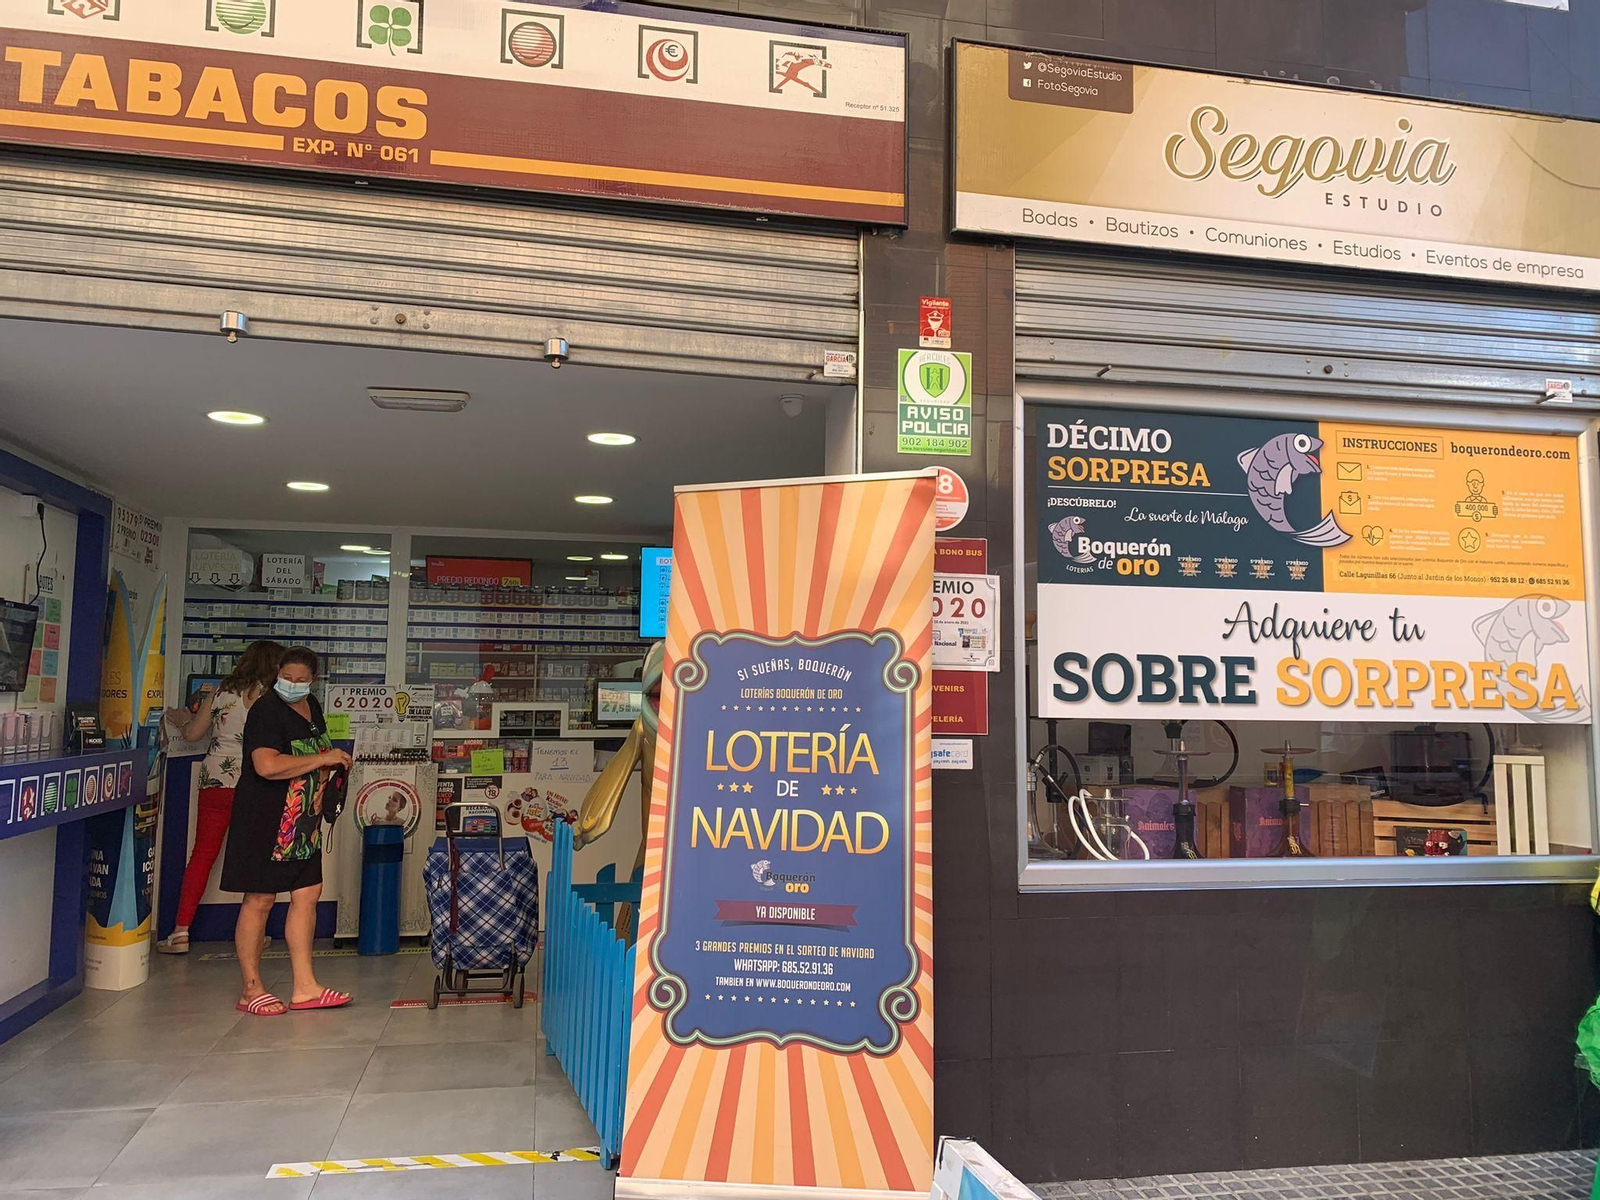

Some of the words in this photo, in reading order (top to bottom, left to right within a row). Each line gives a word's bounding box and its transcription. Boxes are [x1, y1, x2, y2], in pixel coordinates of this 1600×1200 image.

[1037, 62, 1122, 82] @SegoviaEstudio
[5, 46, 428, 140] TABACOS
[1037, 79, 1098, 96] FotoSegovia
[845, 101, 871, 110] Receptor
[292, 137, 338, 156] EXP.
[380, 145, 419, 163] 061
[1163, 104, 1457, 199] Segovia
[1326, 193, 1442, 217] ESTUDIO
[1022, 208, 1078, 228] Bodas
[1107, 217, 1178, 238] Bautizos
[1205, 227, 1307, 252] Comuniones
[1333, 240, 1401, 260] Estudios
[1426, 250, 1488, 269] Eventos
[1492, 257, 1511, 271] de
[1517, 262, 1584, 279] empresa
[907, 405, 963, 421] AVISO
[902, 420, 969, 436] POLICIA
[1047, 419, 1172, 453] DÉCIMO
[902, 437, 922, 446] 902
[926, 438, 945, 447] 184
[948, 439, 968, 448] 902
[1342, 437, 1438, 453] INSTRUCCIONES
[1450, 441, 1570, 460] boquerondeoro.com
[1048, 455, 1210, 487] SORPRESA
[1047, 497, 1117, 508] ¡DESCÚBRELO!
[1124, 507, 1147, 522] La
[1149, 510, 1183, 523] suerte
[1185, 510, 1199, 523] de
[1200, 510, 1249, 532] Málaga
[966, 549, 983, 557] BUS
[1078, 537, 1171, 560] Boquerón
[1066, 564, 1094, 574] LOTERIAS
[1098, 557, 1113, 570] de
[1116, 558, 1160, 576] oro
[266, 576, 301, 584] SÁBADO
[437, 575, 462, 584] PRECIO
[464, 576, 499, 585] REDONDO
[933, 580, 974, 595] EMIO
[933, 597, 986, 619] 020
[1222, 601, 1377, 659] Adquiere
[1390, 607, 1425, 643] tu
[737, 668, 749, 681] SI
[751, 658, 794, 676] SUEÑAS,
[798, 658, 853, 682] BOQUERÓN
[933, 685, 965, 693] VENIRS
[1053, 652, 1257, 705] SOBRE
[1276, 657, 1580, 710] SORPRESA
[350, 688, 387, 696] PREMIO
[740, 686, 775, 699] LOTERÍAS
[776, 687, 815, 699] BOQUERÓN
[817, 689, 826, 699] DE
[827, 689, 843, 699] ORO
[334, 697, 393, 708] 62020
[933, 714, 964, 723] ELERÍA
[706, 723, 880, 776] LOTERÍA
[931, 749, 968, 758] safecard
[776, 780, 799, 797] DE
[691, 806, 889, 855] NAVIDAD
[766, 872, 816, 883] Boquerón
[785, 882, 810, 893] oro
[755, 905, 767, 918] YA
[769, 906, 816, 920] DISPONIBLE
[695, 941, 701, 951] 3
[703, 941, 737, 953] GRANDES
[739, 942, 772, 954] PREMIOS
[775, 945, 784, 955] EN
[787, 945, 795, 955] EL
[797, 946, 827, 957] SORTEO
[829, 947, 839, 957] DE
[841, 947, 875, 959] NAVIDAD
[734, 958, 780, 973] WHATSAPP:
[781, 962, 834, 975] 685.52.91.36
[715, 976, 744, 987] TAMBIEN
[745, 977, 754, 987] EN
[755, 978, 851, 992] WWW.BOQUERONDEORO.COM
